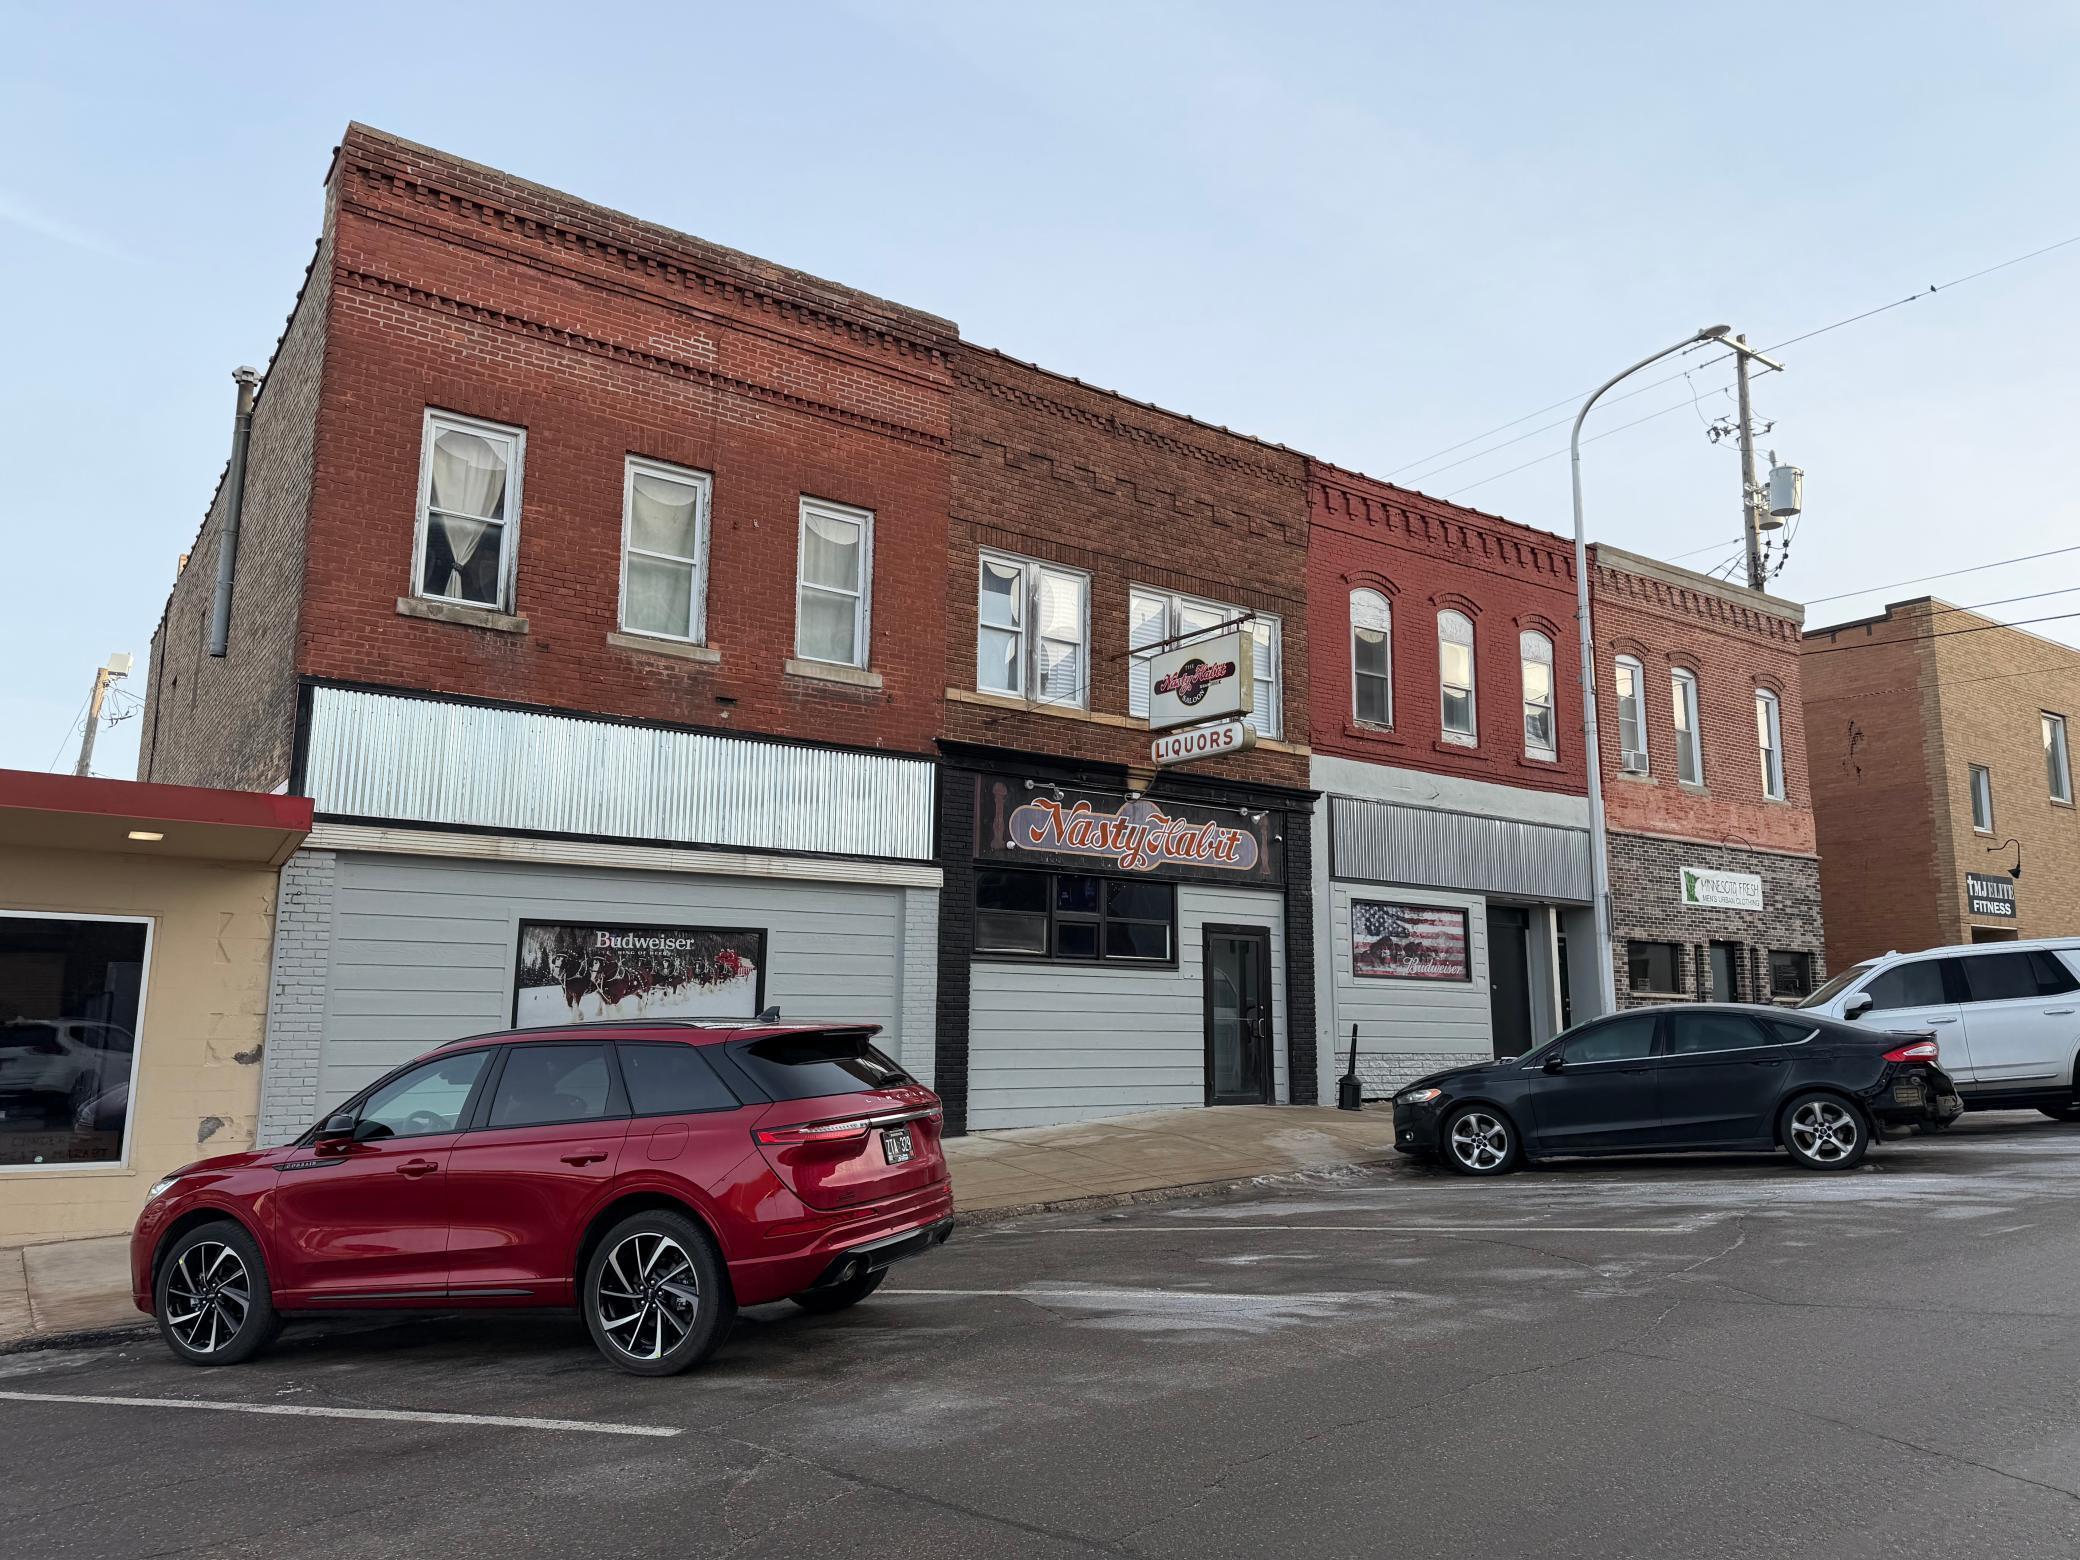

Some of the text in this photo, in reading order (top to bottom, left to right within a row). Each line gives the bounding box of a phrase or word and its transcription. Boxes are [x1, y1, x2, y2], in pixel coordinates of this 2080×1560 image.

[1182, 690, 1206, 704] SALOON
[1156, 728, 1234, 759] LIQUORS
[1029, 797, 1243, 870] Nasty Habit
[1738, 882, 1759, 897] FRESH
[1702, 894, 1760, 907] MEN'S URBAN CLOTHING
[1973, 899, 2012, 915] FITNESS
[595, 931, 695, 950] Budweiser
[1402, 956, 1463, 976] Budweiser
